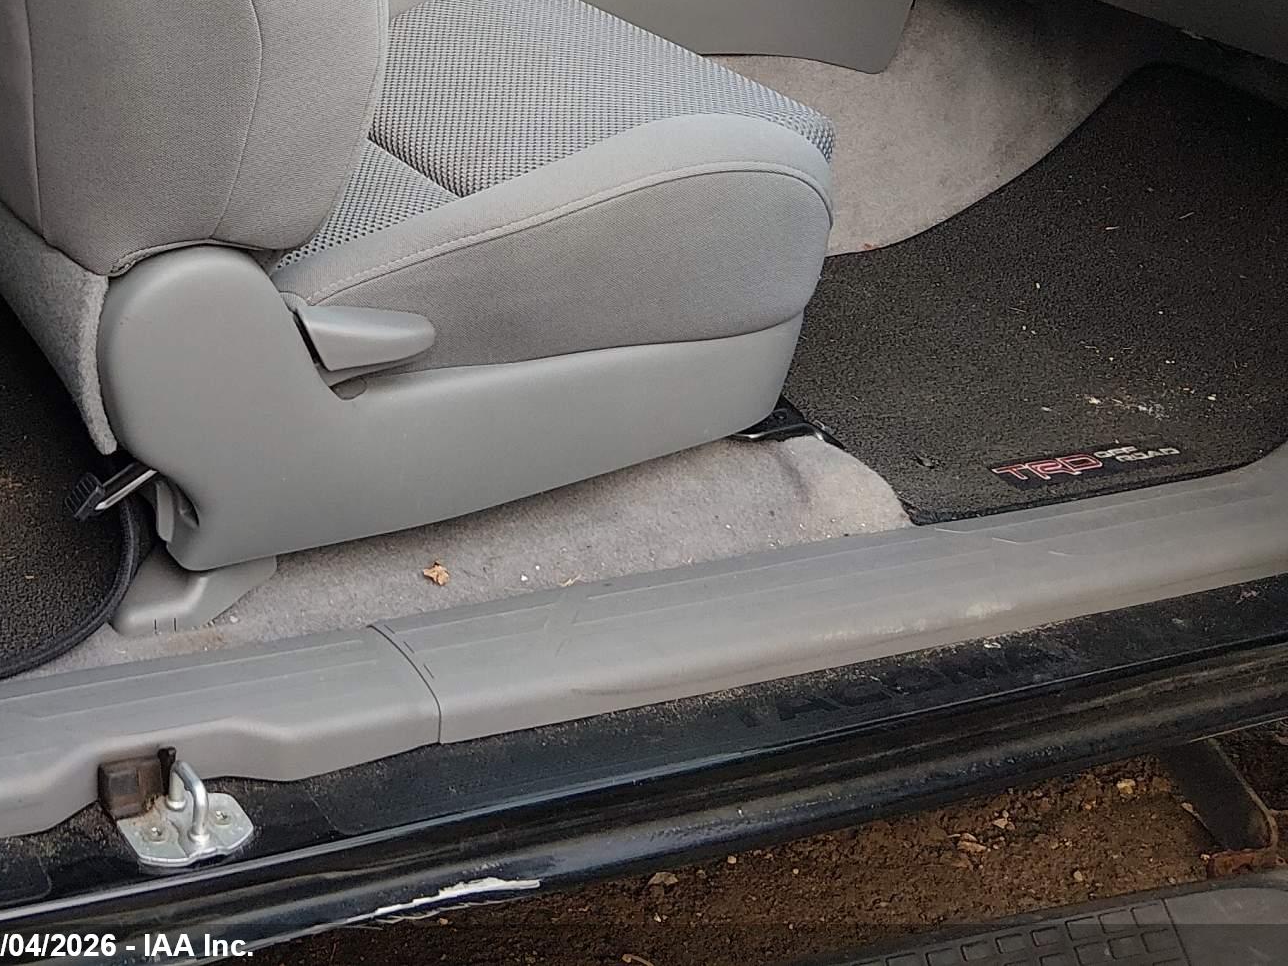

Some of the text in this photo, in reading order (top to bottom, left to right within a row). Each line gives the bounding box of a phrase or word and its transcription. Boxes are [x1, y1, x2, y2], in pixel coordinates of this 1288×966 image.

[1093, 445, 1138, 459] OFF
[1116, 447, 1181, 463] ROAD
[991, 453, 1104, 480] TRD
